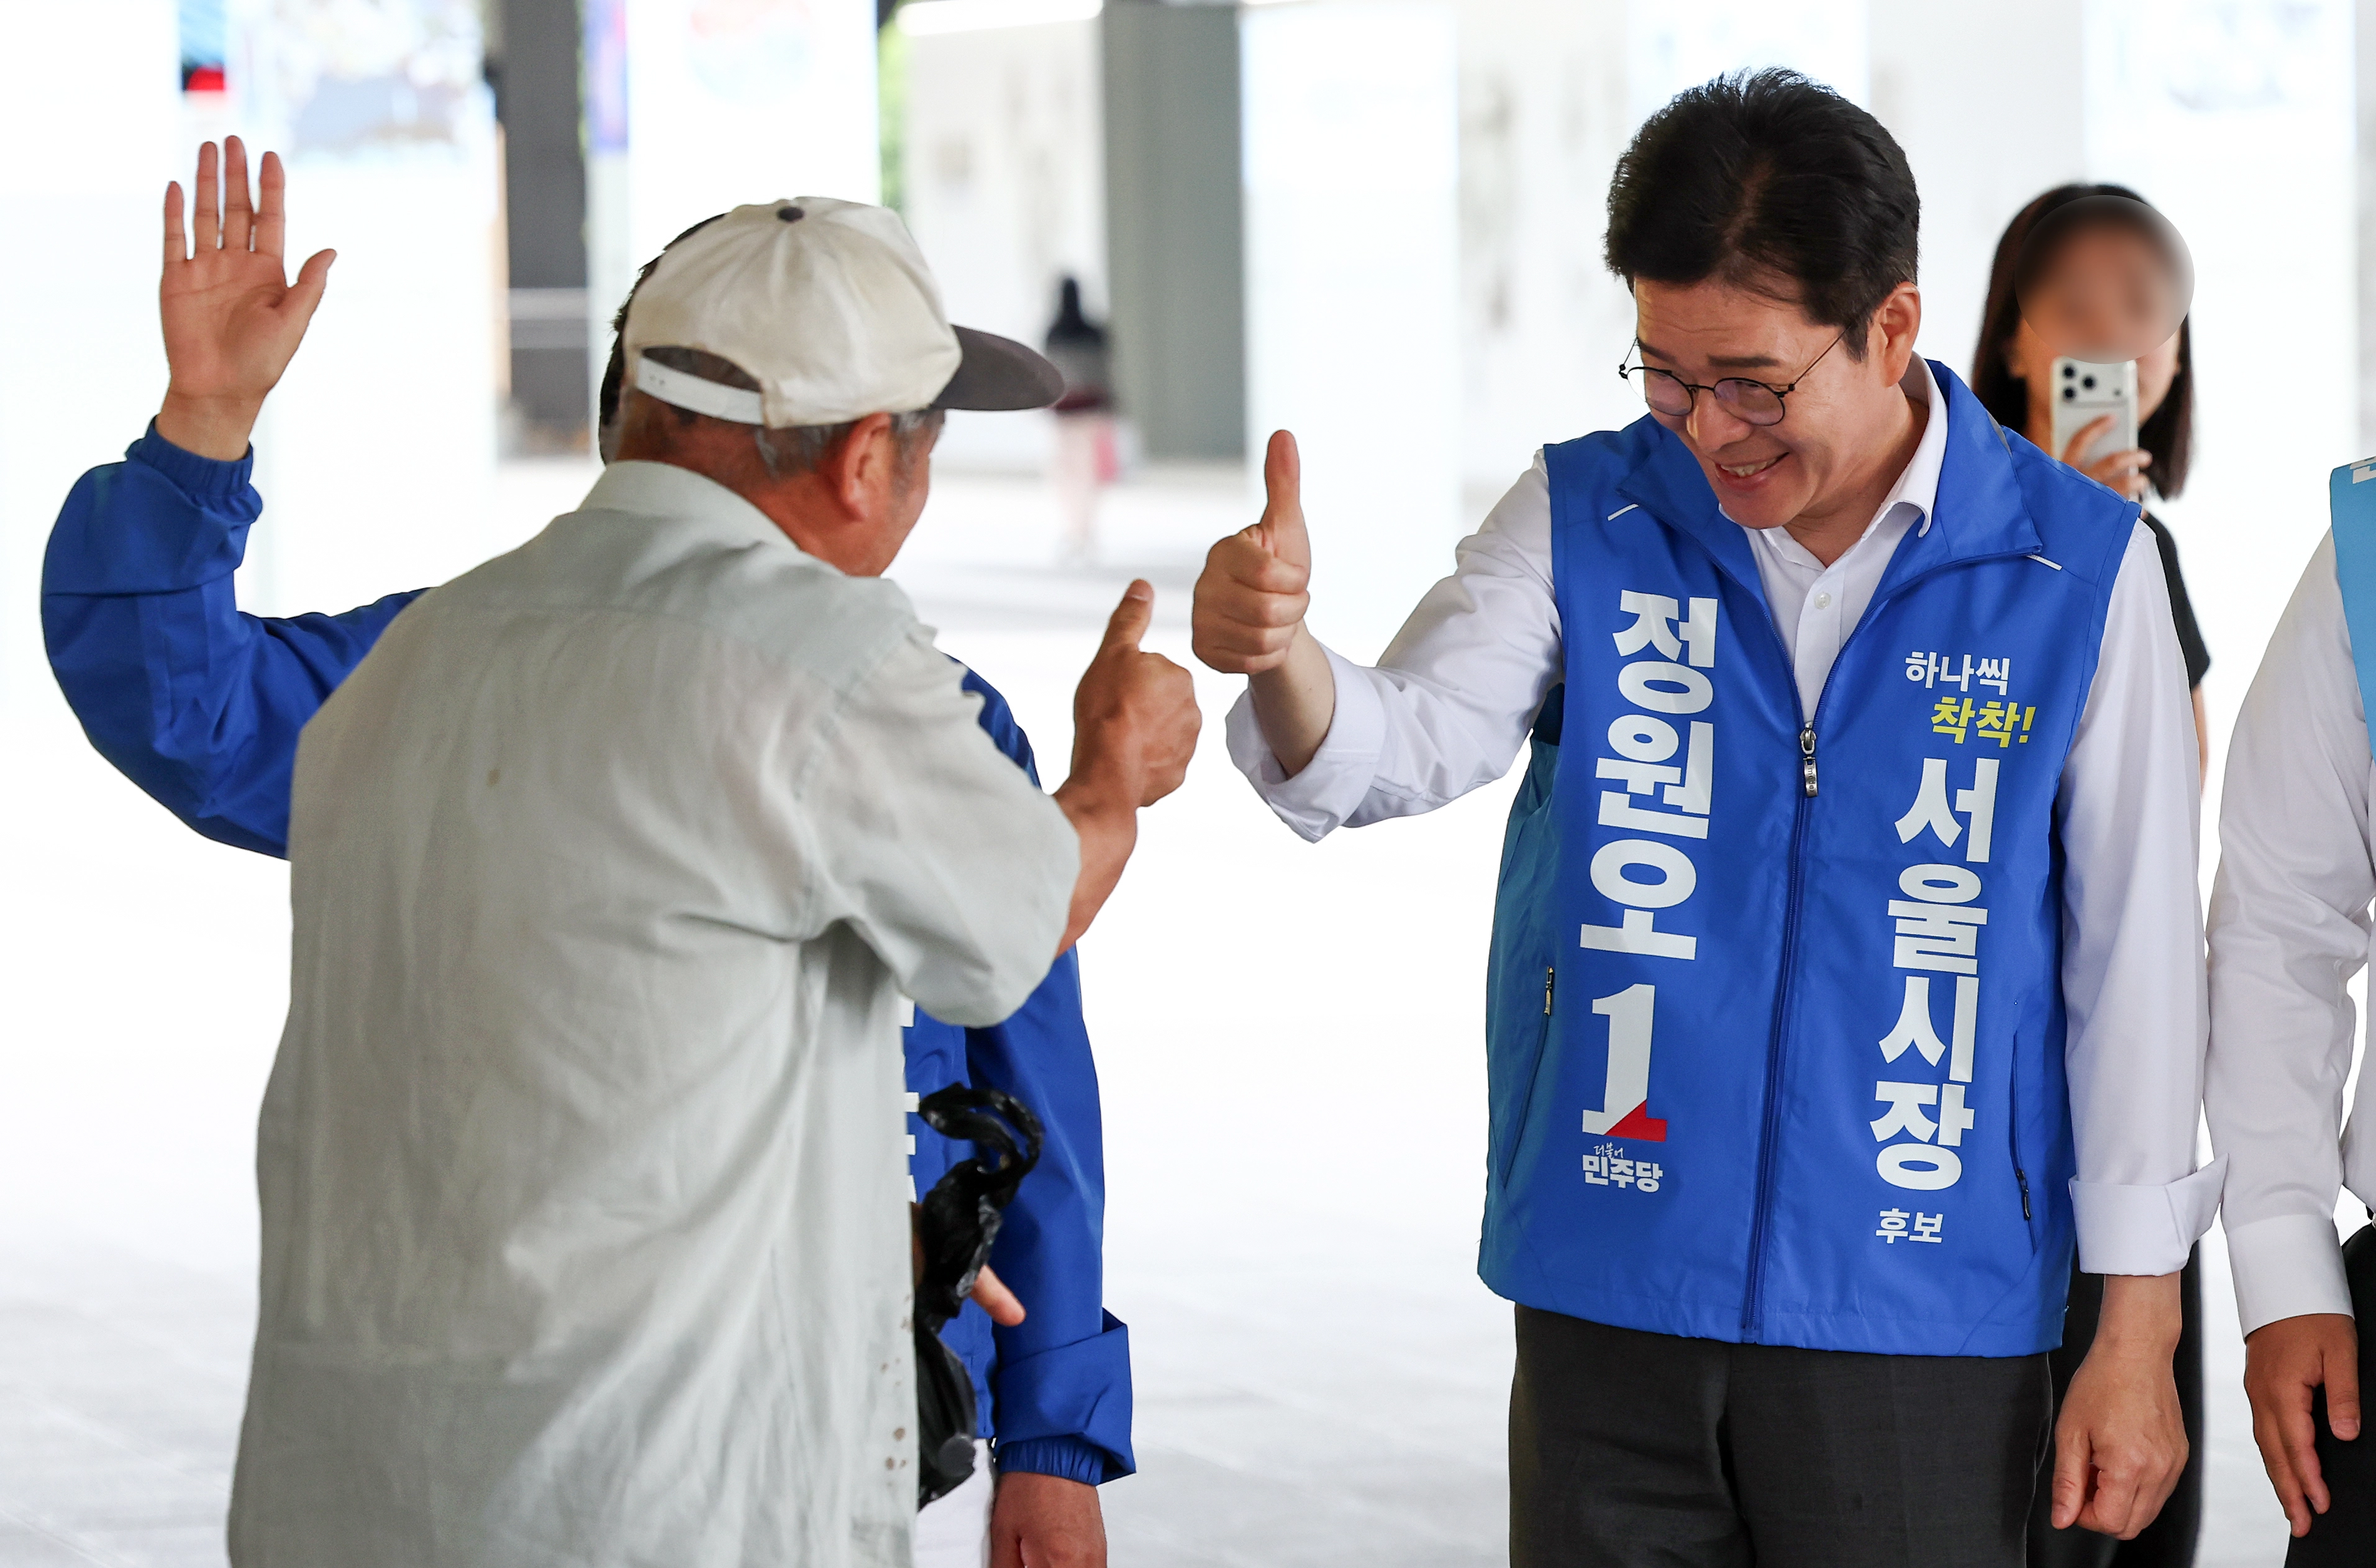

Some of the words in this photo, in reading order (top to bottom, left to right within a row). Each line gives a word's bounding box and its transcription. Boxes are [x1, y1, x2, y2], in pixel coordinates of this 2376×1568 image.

[1905, 652, 2010, 696] 하나씩
[1931, 696, 2036, 748] 착착!
[1580, 590, 1718, 960] 정원오
[1869, 758, 2000, 1191] 서울시장
[1582, 983, 1667, 1142] 1
[1582, 1155, 1664, 1193] 민주당
[1593, 1142, 1624, 1160] 더불어
[1876, 1208, 1943, 1244] 후보
